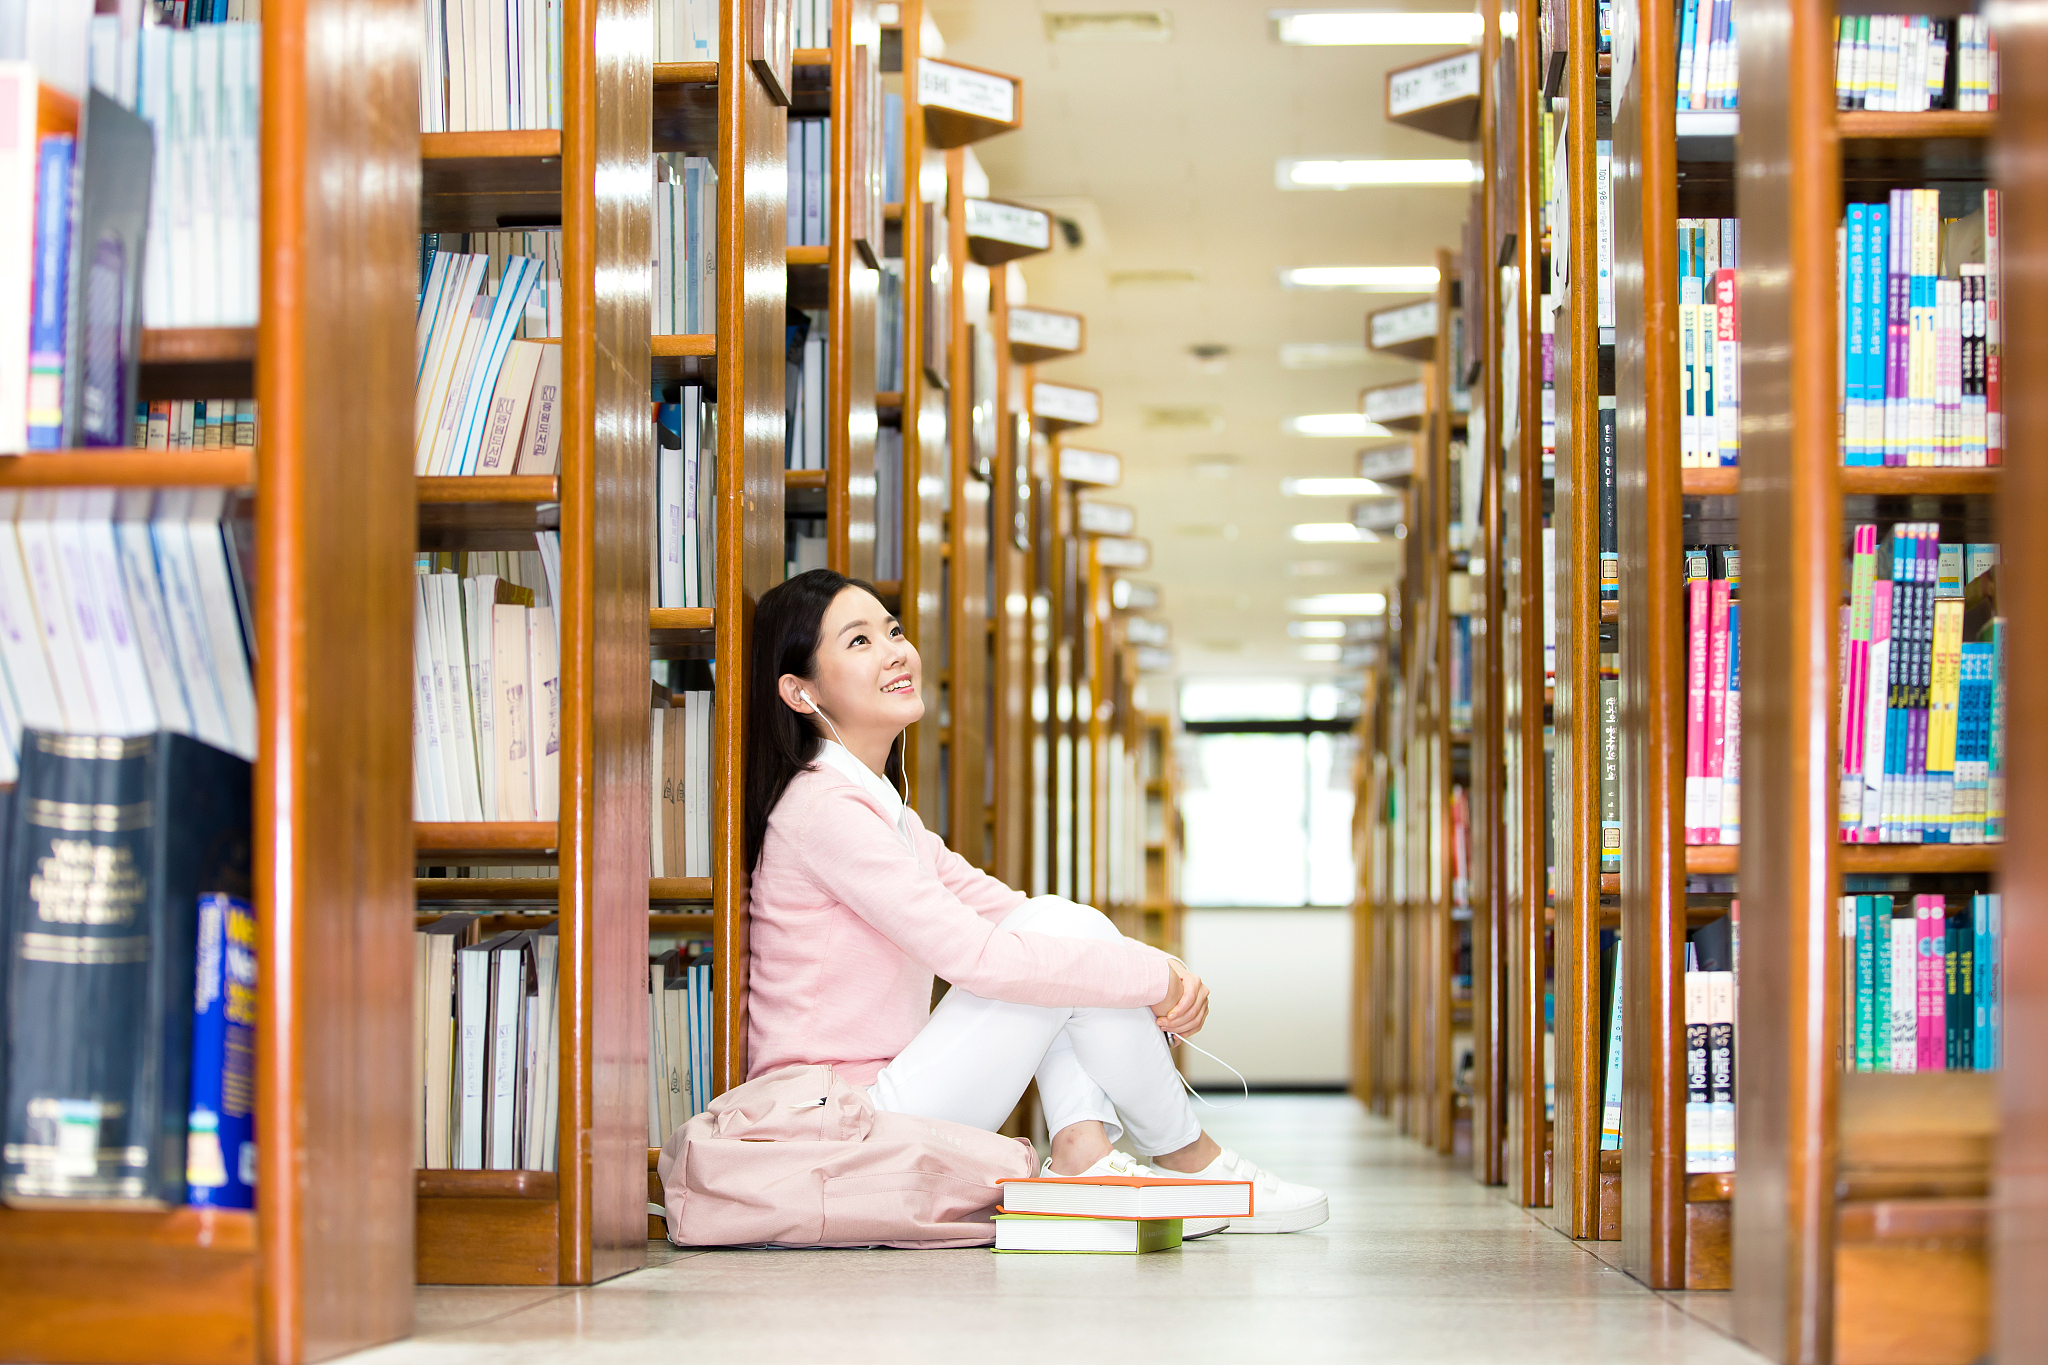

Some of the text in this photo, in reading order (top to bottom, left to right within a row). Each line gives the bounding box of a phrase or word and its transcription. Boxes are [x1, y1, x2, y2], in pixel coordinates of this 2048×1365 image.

[1605, 697, 1618, 723] 한국어
[1605, 763, 1618, 781] 모색
[1688, 1048, 1708, 1088] 일본어
[1712, 1048, 1731, 1088] 일본어
